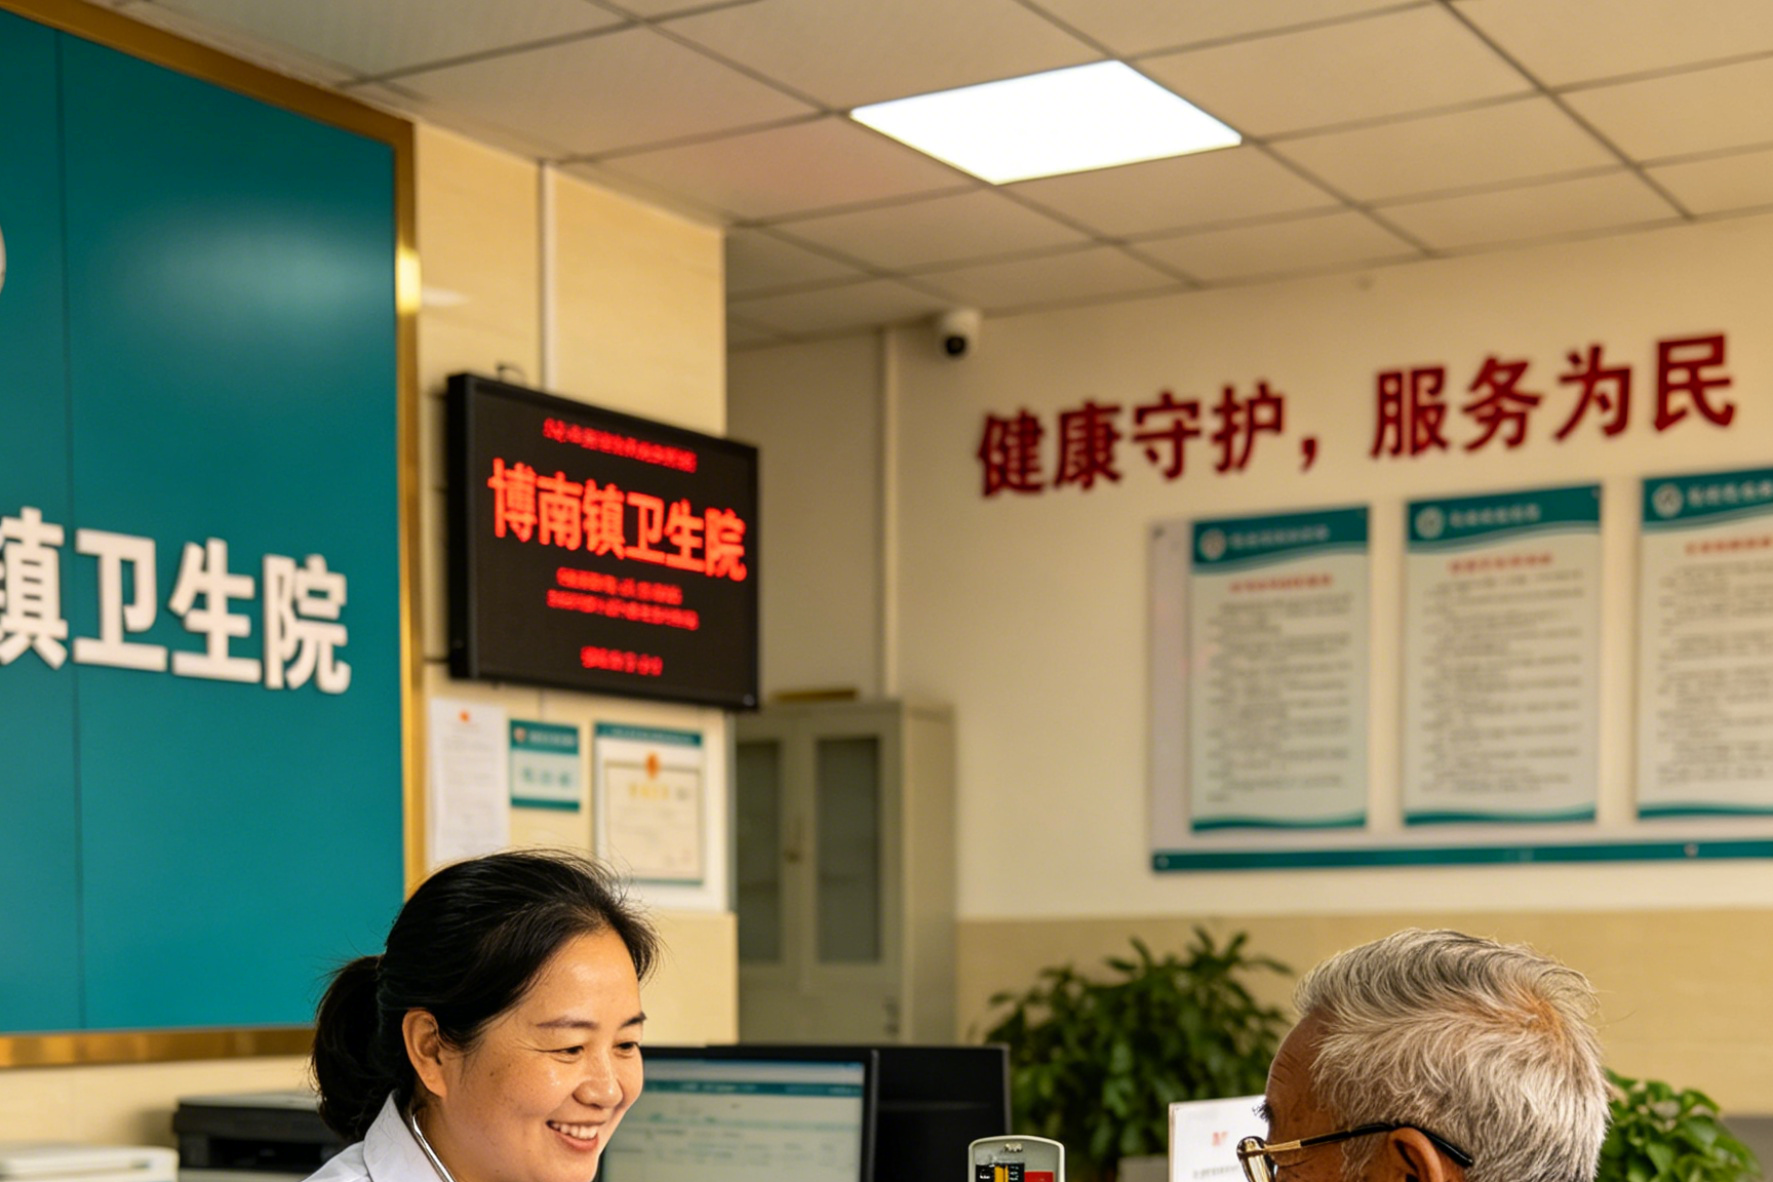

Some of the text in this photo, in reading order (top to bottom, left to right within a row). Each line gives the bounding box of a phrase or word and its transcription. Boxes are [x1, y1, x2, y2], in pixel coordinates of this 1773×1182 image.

[977, 333, 1736, 499] 健康守护，服务为民
[487, 457, 747, 582] 博南镇卫生院
